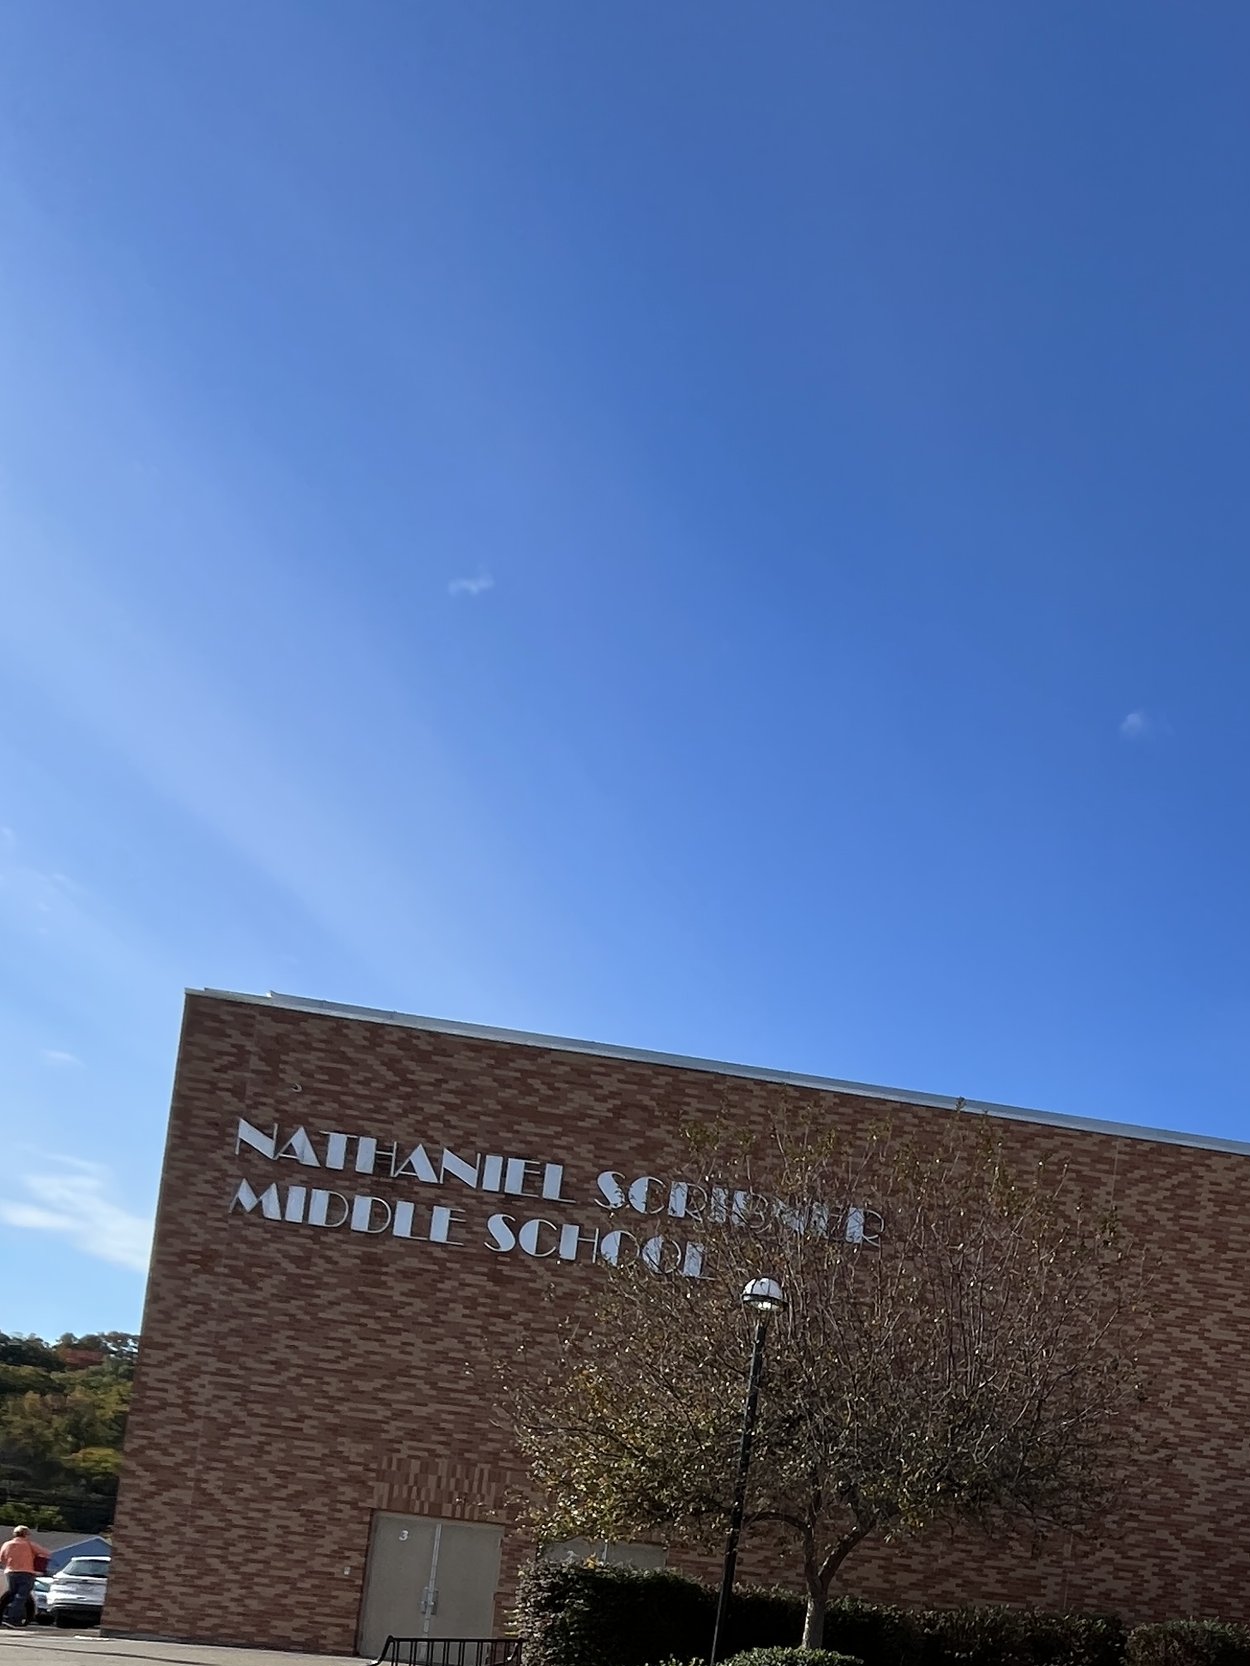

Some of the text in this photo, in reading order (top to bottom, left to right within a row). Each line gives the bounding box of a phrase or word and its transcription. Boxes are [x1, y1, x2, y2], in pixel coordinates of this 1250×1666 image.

[235, 1117, 577, 1204] NATHANIEL
[229, 1178, 717, 1280] MIDDLE SCHOOL
[398, 1530, 409, 1541] 3
